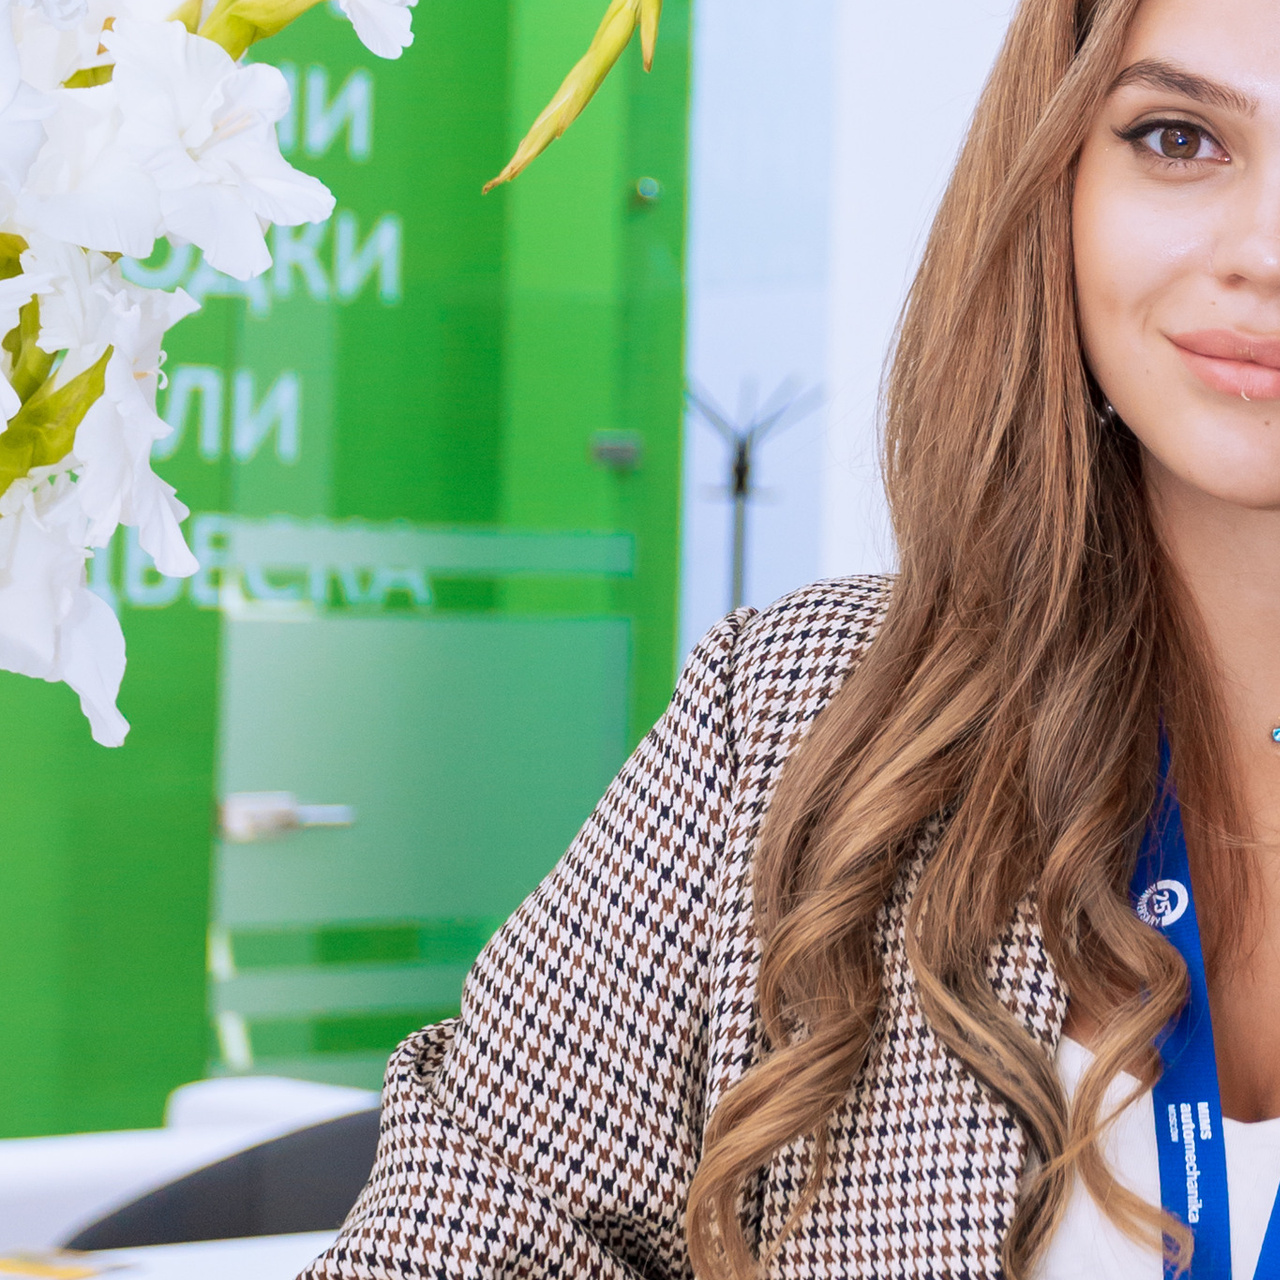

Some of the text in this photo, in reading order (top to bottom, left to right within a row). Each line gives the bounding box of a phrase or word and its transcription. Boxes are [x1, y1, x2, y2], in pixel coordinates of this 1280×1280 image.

[1153, 891, 1172, 916] 25
[1197, 1101, 1213, 1140] MIMS
[1180, 1102, 1203, 1224] automechanika
